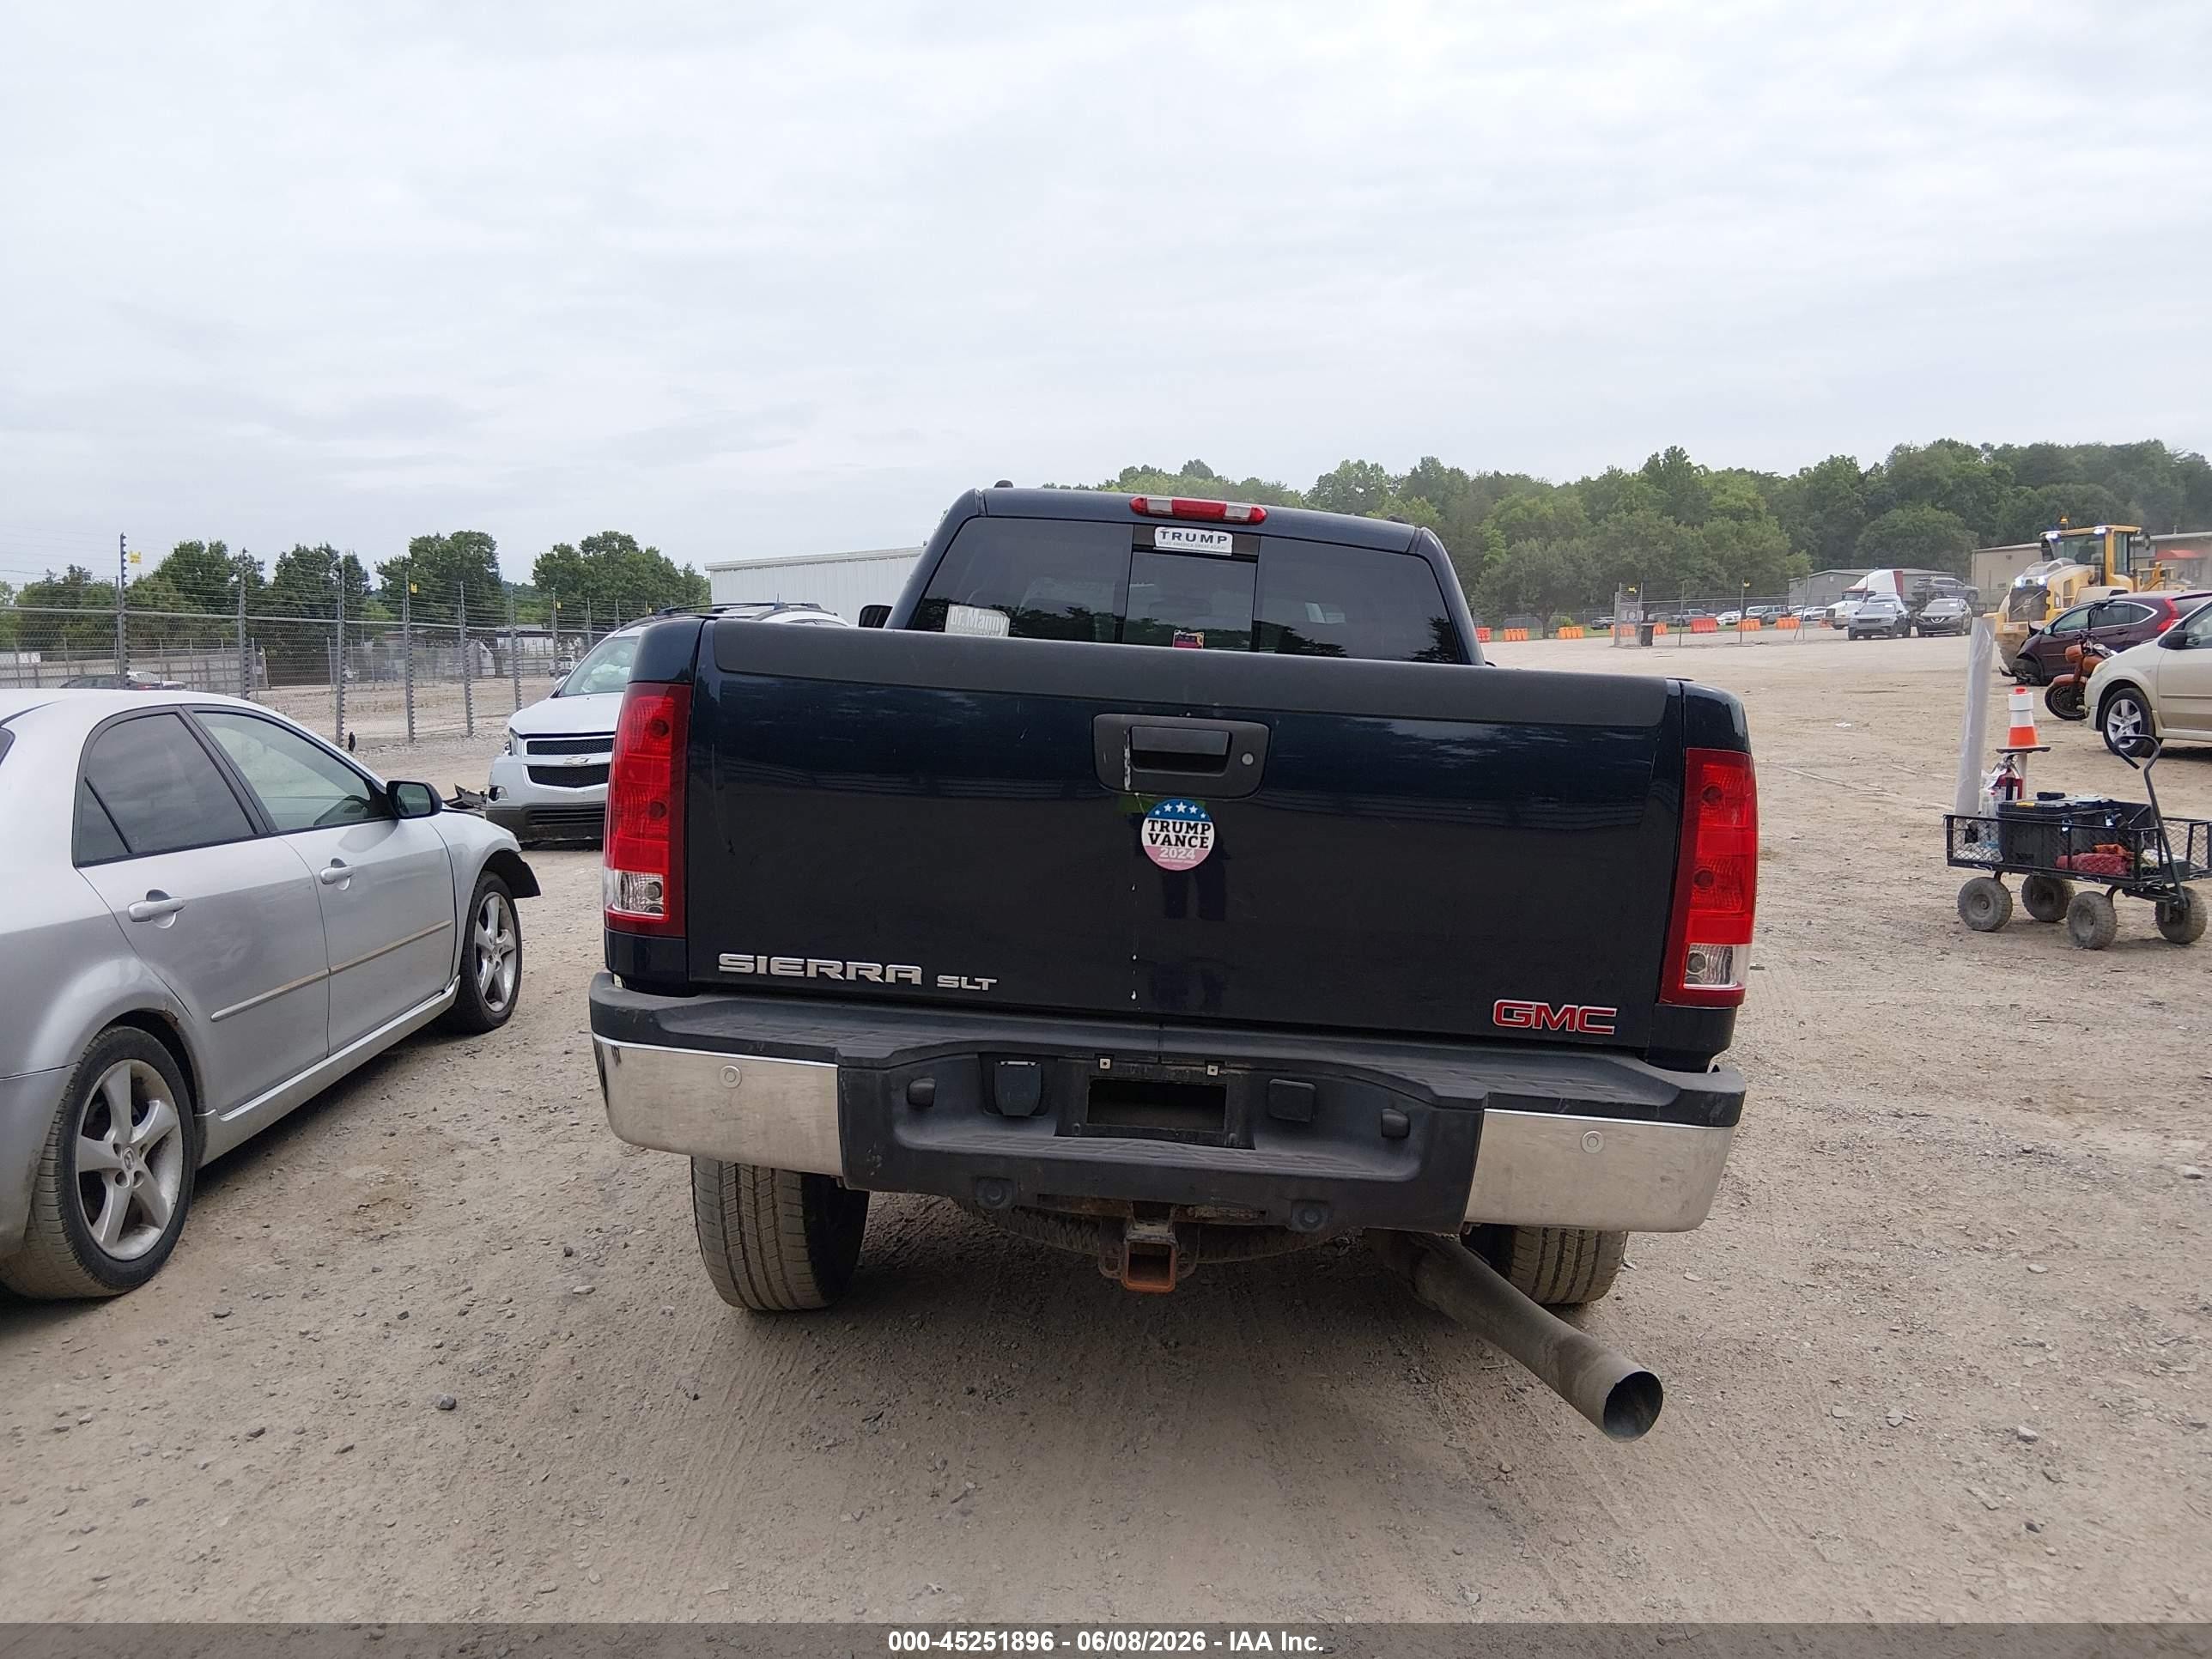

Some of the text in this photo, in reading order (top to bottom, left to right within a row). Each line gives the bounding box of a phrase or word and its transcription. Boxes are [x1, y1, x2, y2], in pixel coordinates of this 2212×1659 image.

[1159, 531, 1228, 544] TRUMP
[1147, 819, 1212, 836] TRUMP
[1147, 833, 1210, 849] VANCE
[1159, 848, 1196, 860] 2024
[718, 952, 998, 991] SIERRA SLT
[1492, 999, 1618, 1036] GMC
